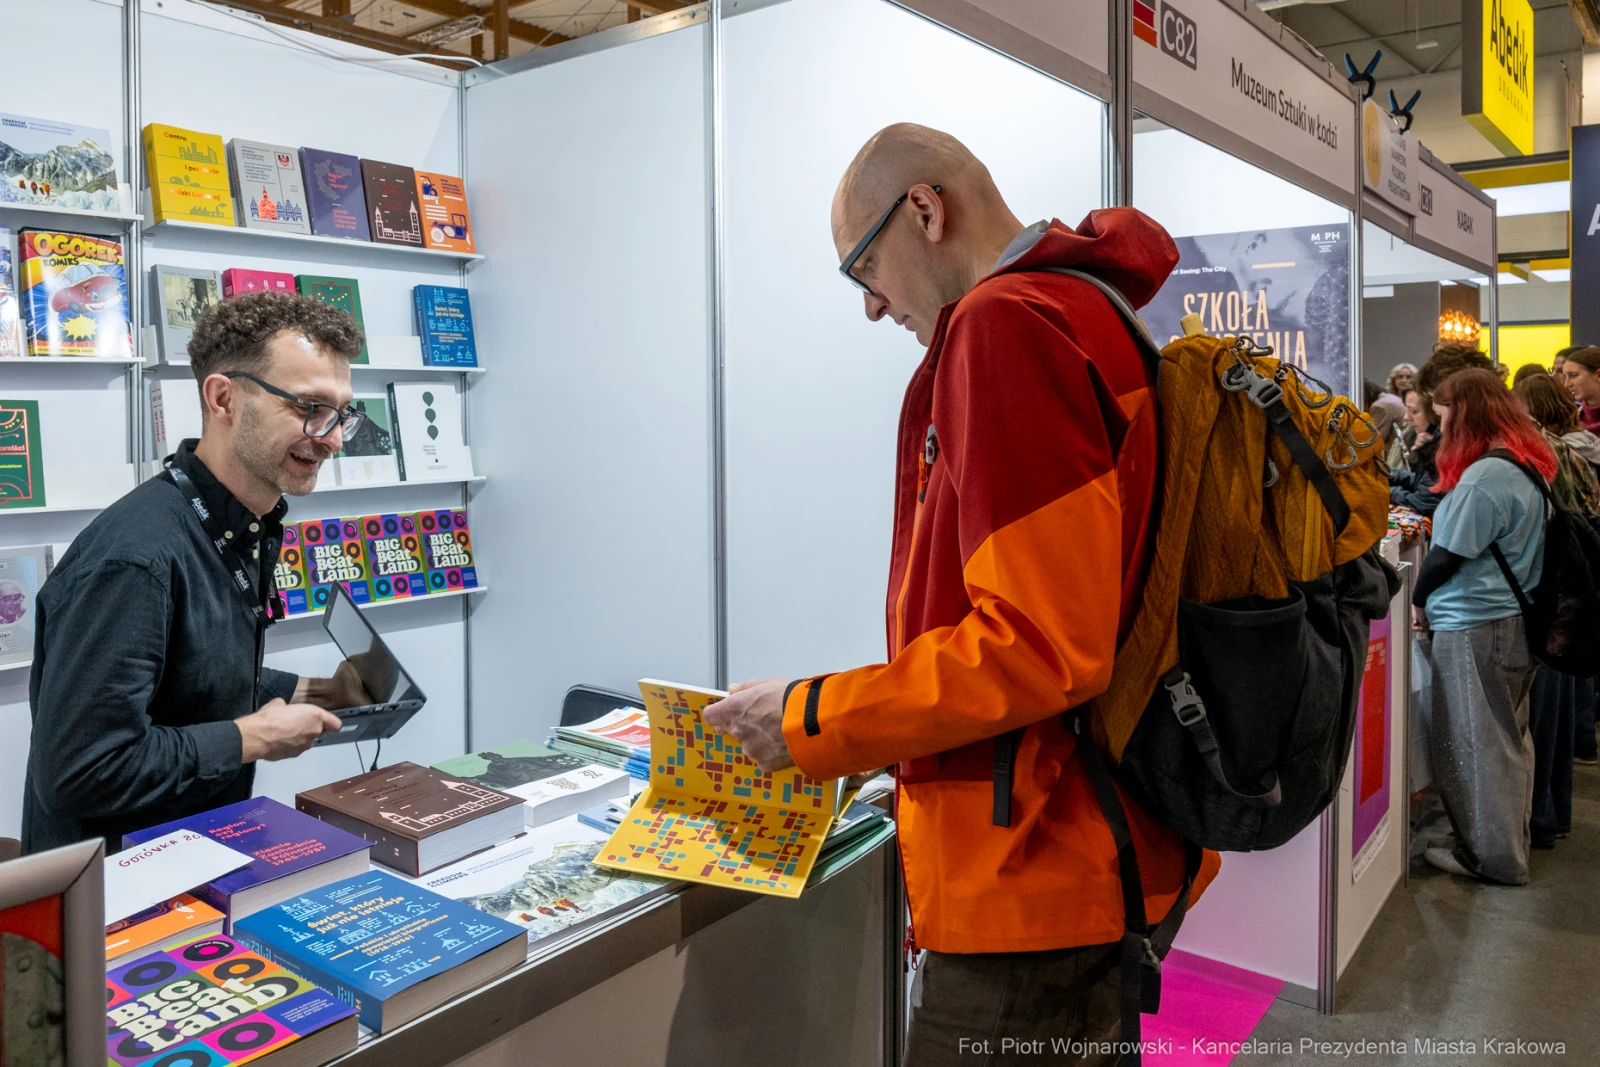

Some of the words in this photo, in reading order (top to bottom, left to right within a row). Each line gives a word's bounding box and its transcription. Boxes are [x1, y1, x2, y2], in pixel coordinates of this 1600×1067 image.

[1162, 9, 1196, 66] C82
[1490, 0, 1528, 99] Abedik
[1231, 57, 1277, 114] Muzeum
[1278, 89, 1307, 131] Sztuki
[1307, 113, 1316, 136] w
[1316, 114, 1338, 150] Łodzi
[164, 131, 187, 142] Centra
[33, 232, 120, 264] OGÓREK
[43, 257, 80, 267] KOMIKS
[1183, 289, 1270, 335] SZKOŁA
[374, 538, 400, 552] BIG
[429, 533, 454, 546] BIG
[314, 544, 342, 559] BIG
[376, 548, 413, 563] Beat
[431, 543, 463, 557] Beat
[316, 555, 354, 571] Beat
[208, 821, 246, 834] Region
[216, 827, 233, 837] czy
[221, 823, 266, 840] regiony?
[252, 842, 291, 857] Ziemie
[259, 839, 317, 860] Zachodnie
[426, 871, 464, 887] FREEDOM
[430, 873, 470, 888] CLIMBERS
[349, 896, 385, 912] który
[316, 922, 338, 935] już
[338, 914, 359, 925] nie
[358, 896, 405, 916] istnieje
[106, 980, 200, 1027] BIG
[120, 977, 255, 1039] Beat
